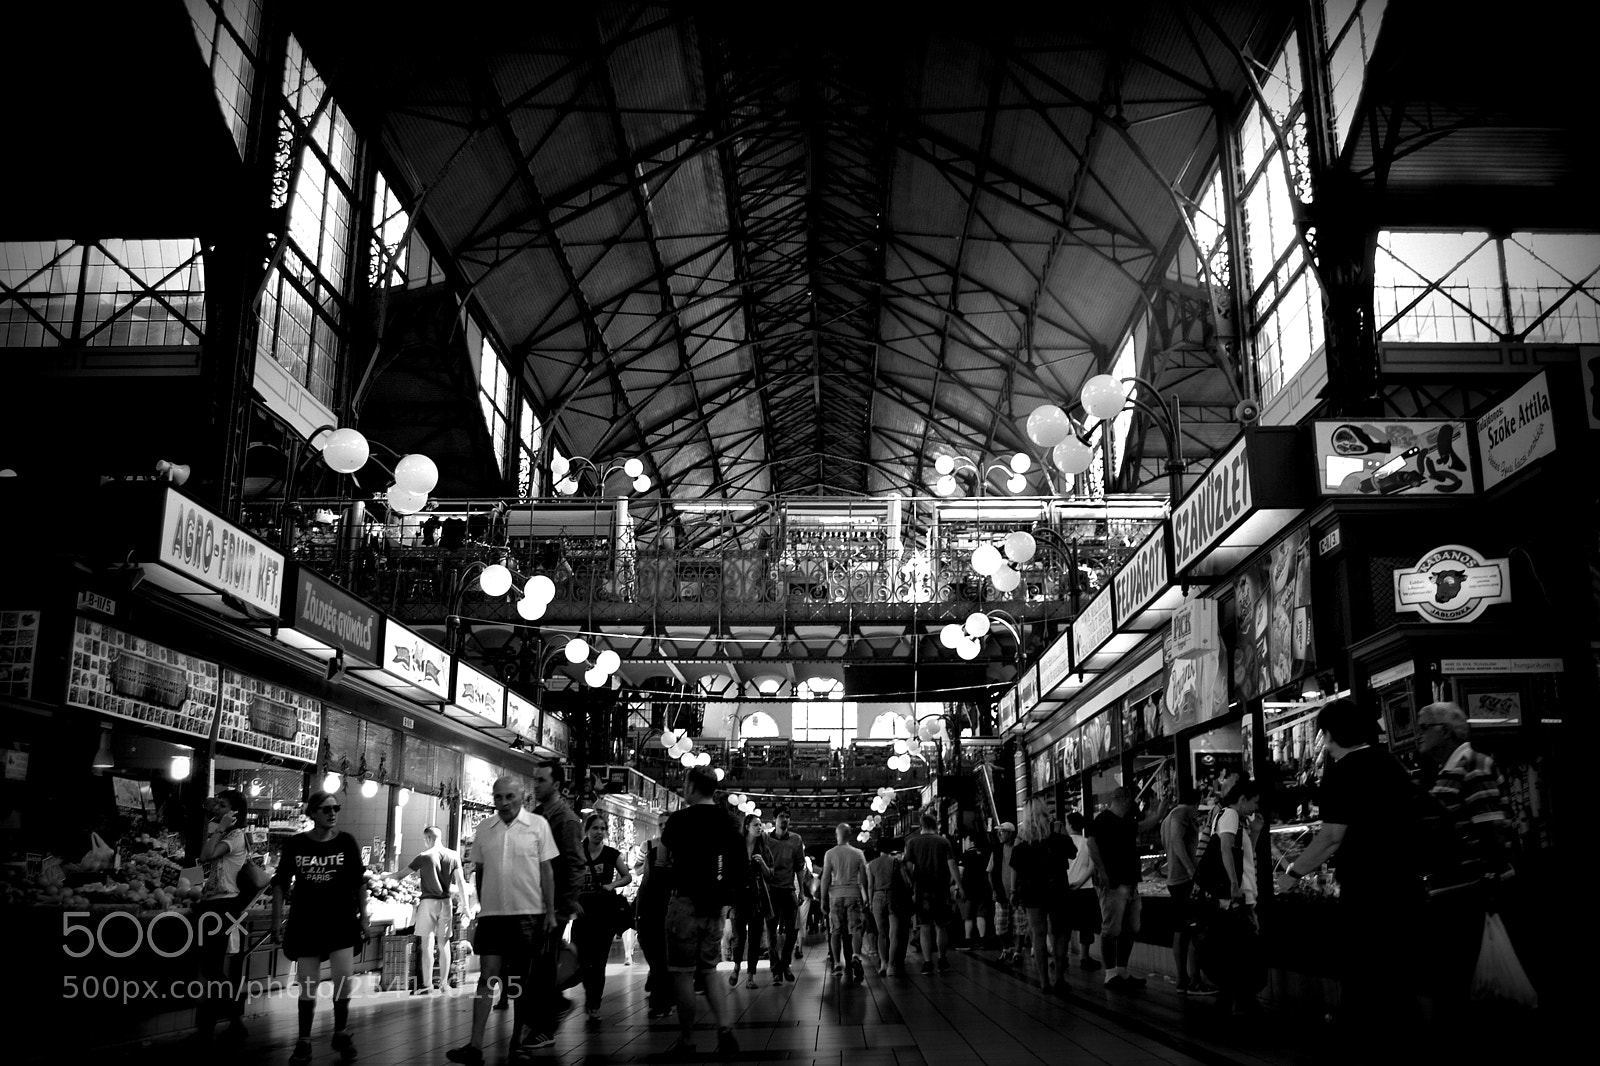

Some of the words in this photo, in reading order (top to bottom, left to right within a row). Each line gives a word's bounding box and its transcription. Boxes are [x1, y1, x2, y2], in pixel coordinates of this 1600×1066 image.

[1519, 391, 1550, 429] Attila
[1175, 446, 1248, 567] SZAKÜZLET
[172, 503, 256, 593] AGRO-FRUIT
[256, 552, 279, 609] KFT.
[1419, 550, 1478, 573] KABANOS
[1116, 538, 1166, 621] FELVÁGOTT
[1173, 609, 1192, 641] PICK
[295, 852, 345, 867] BEAUTÉ
